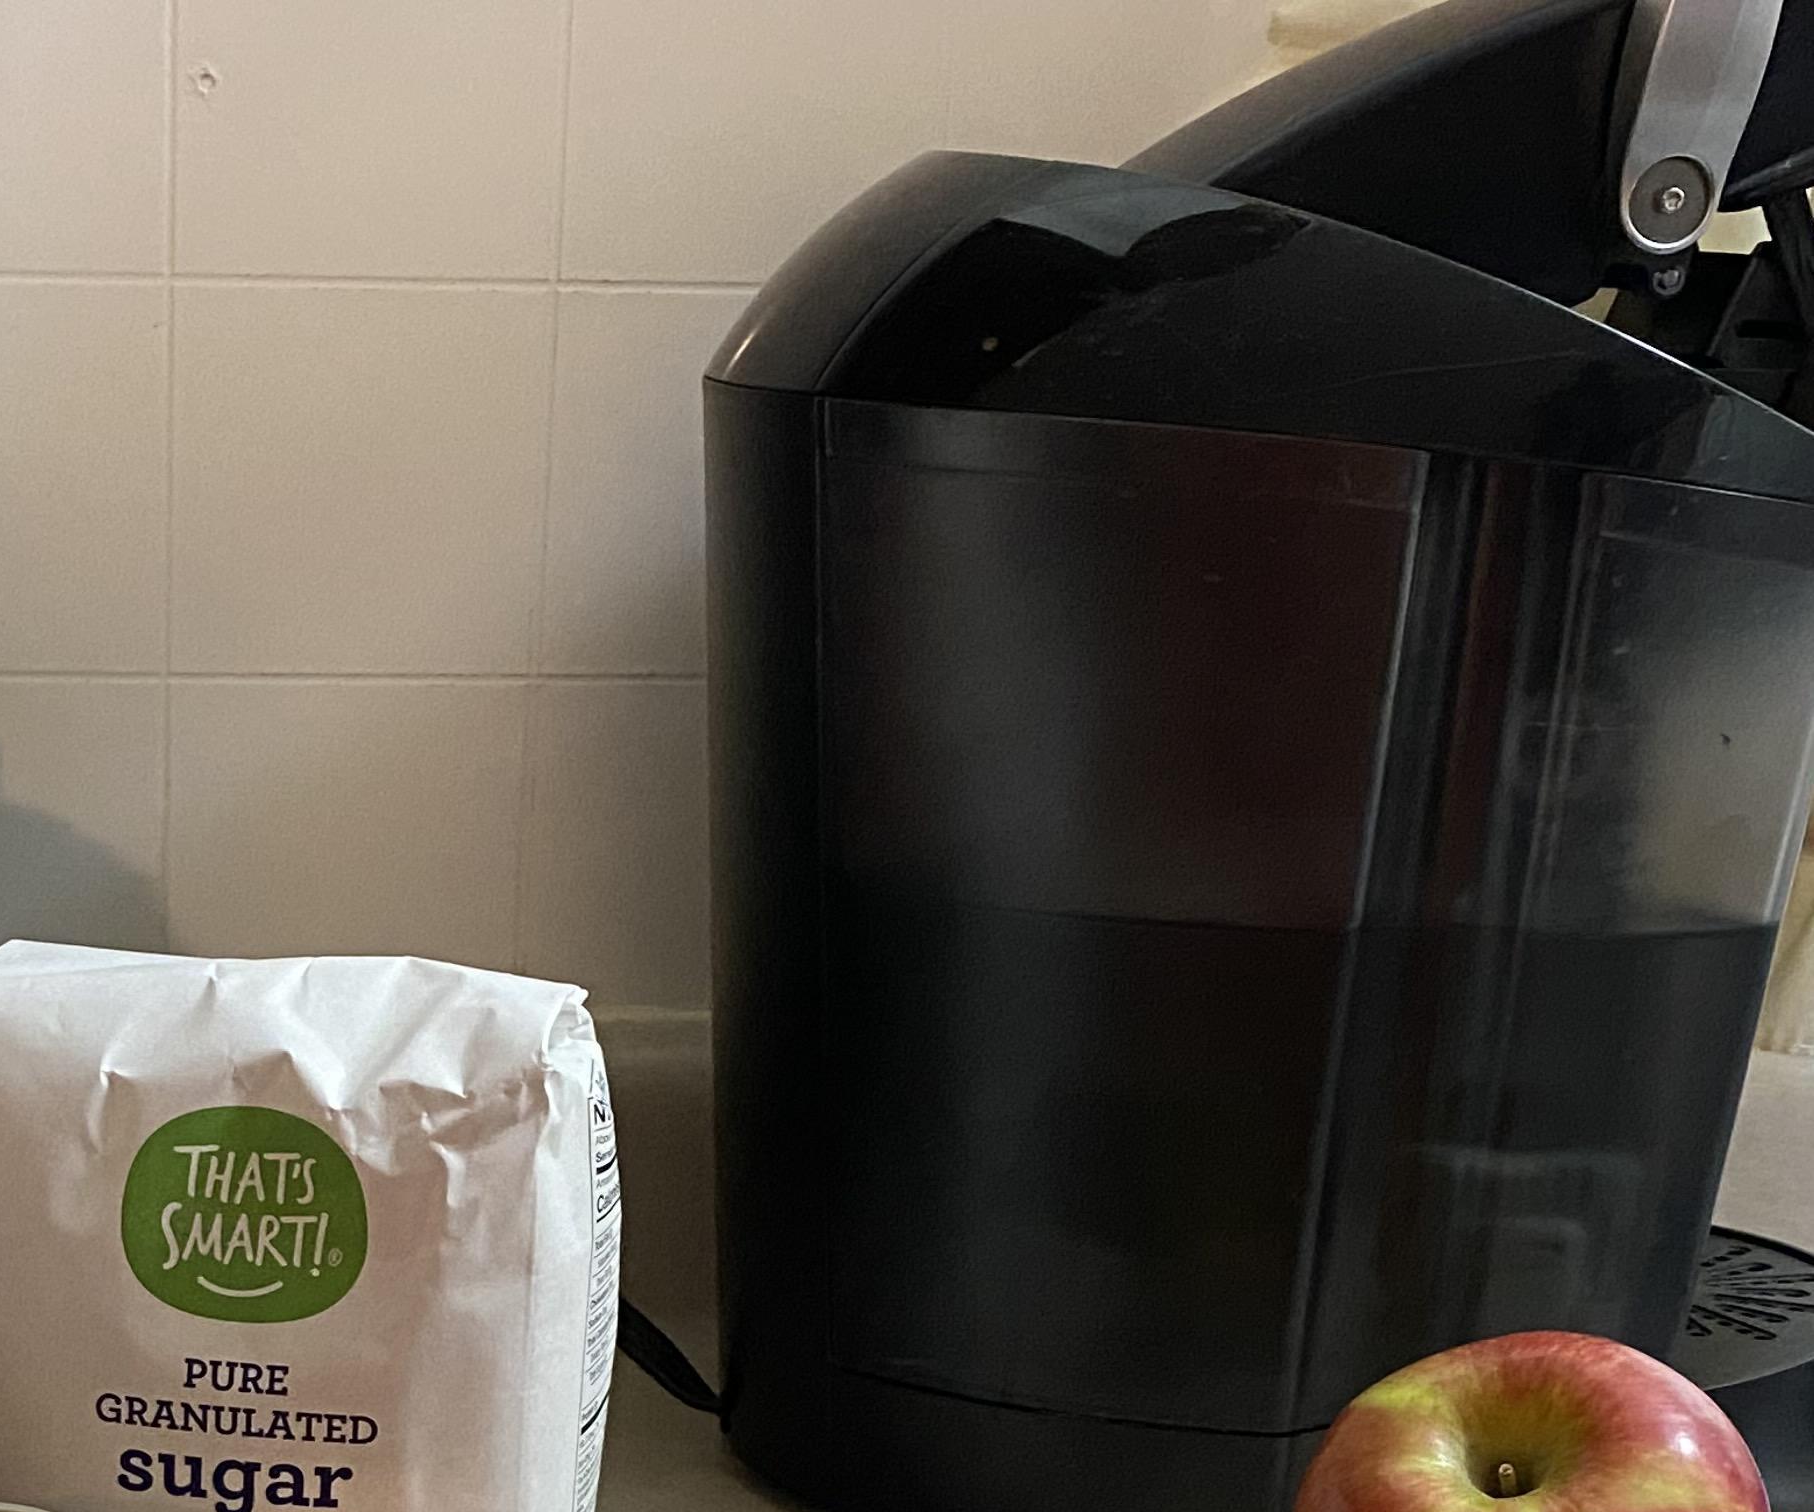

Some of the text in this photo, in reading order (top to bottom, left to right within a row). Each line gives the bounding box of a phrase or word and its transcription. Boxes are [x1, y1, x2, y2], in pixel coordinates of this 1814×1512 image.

[172, 1142, 318, 1207] THAT'S
[161, 1200, 331, 1277] SMART!
[185, 1358, 290, 1394] PURE
[96, 1394, 378, 1445] GRANULATED
